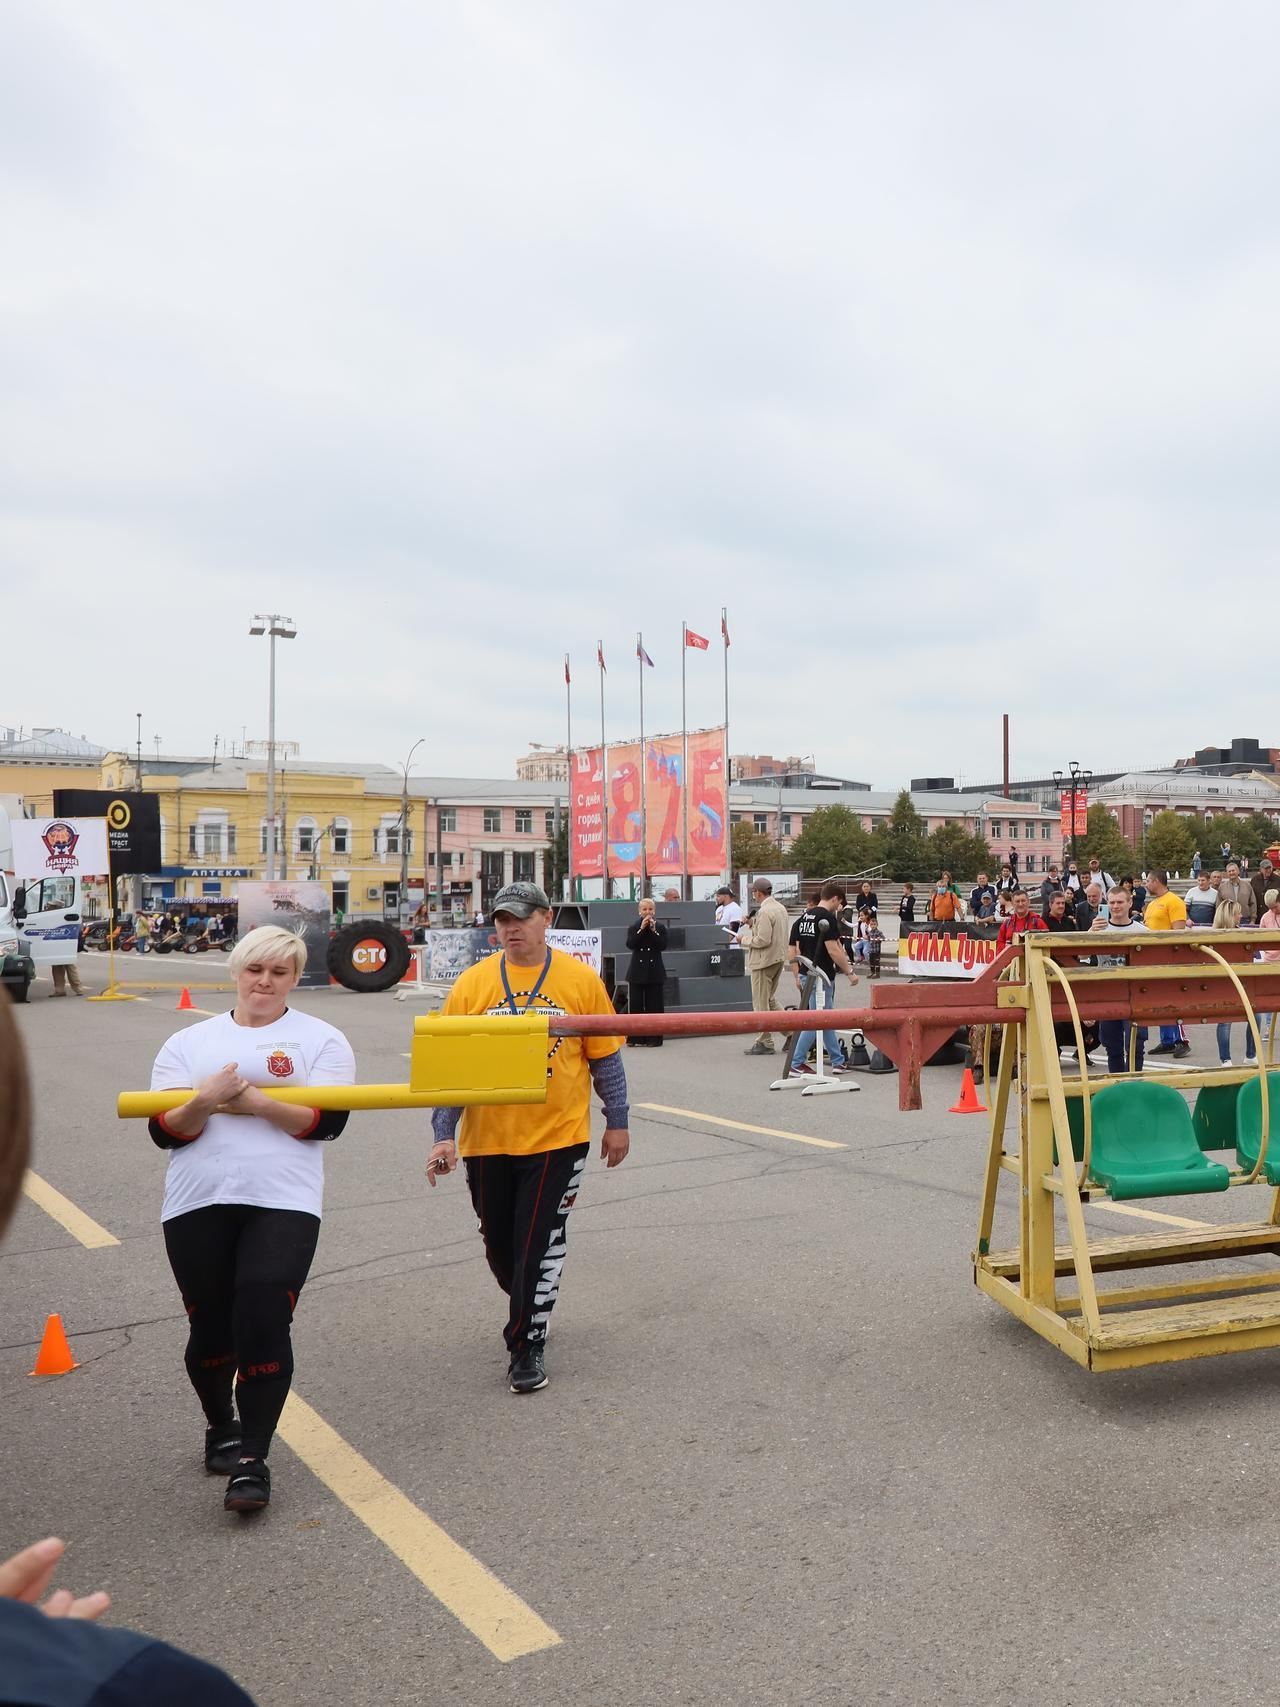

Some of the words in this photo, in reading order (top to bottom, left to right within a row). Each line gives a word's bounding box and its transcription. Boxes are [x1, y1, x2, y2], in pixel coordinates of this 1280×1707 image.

[577, 794, 584, 806] С
[907, 931, 953, 963] СИЛА
[711, 955, 721, 963] 220
